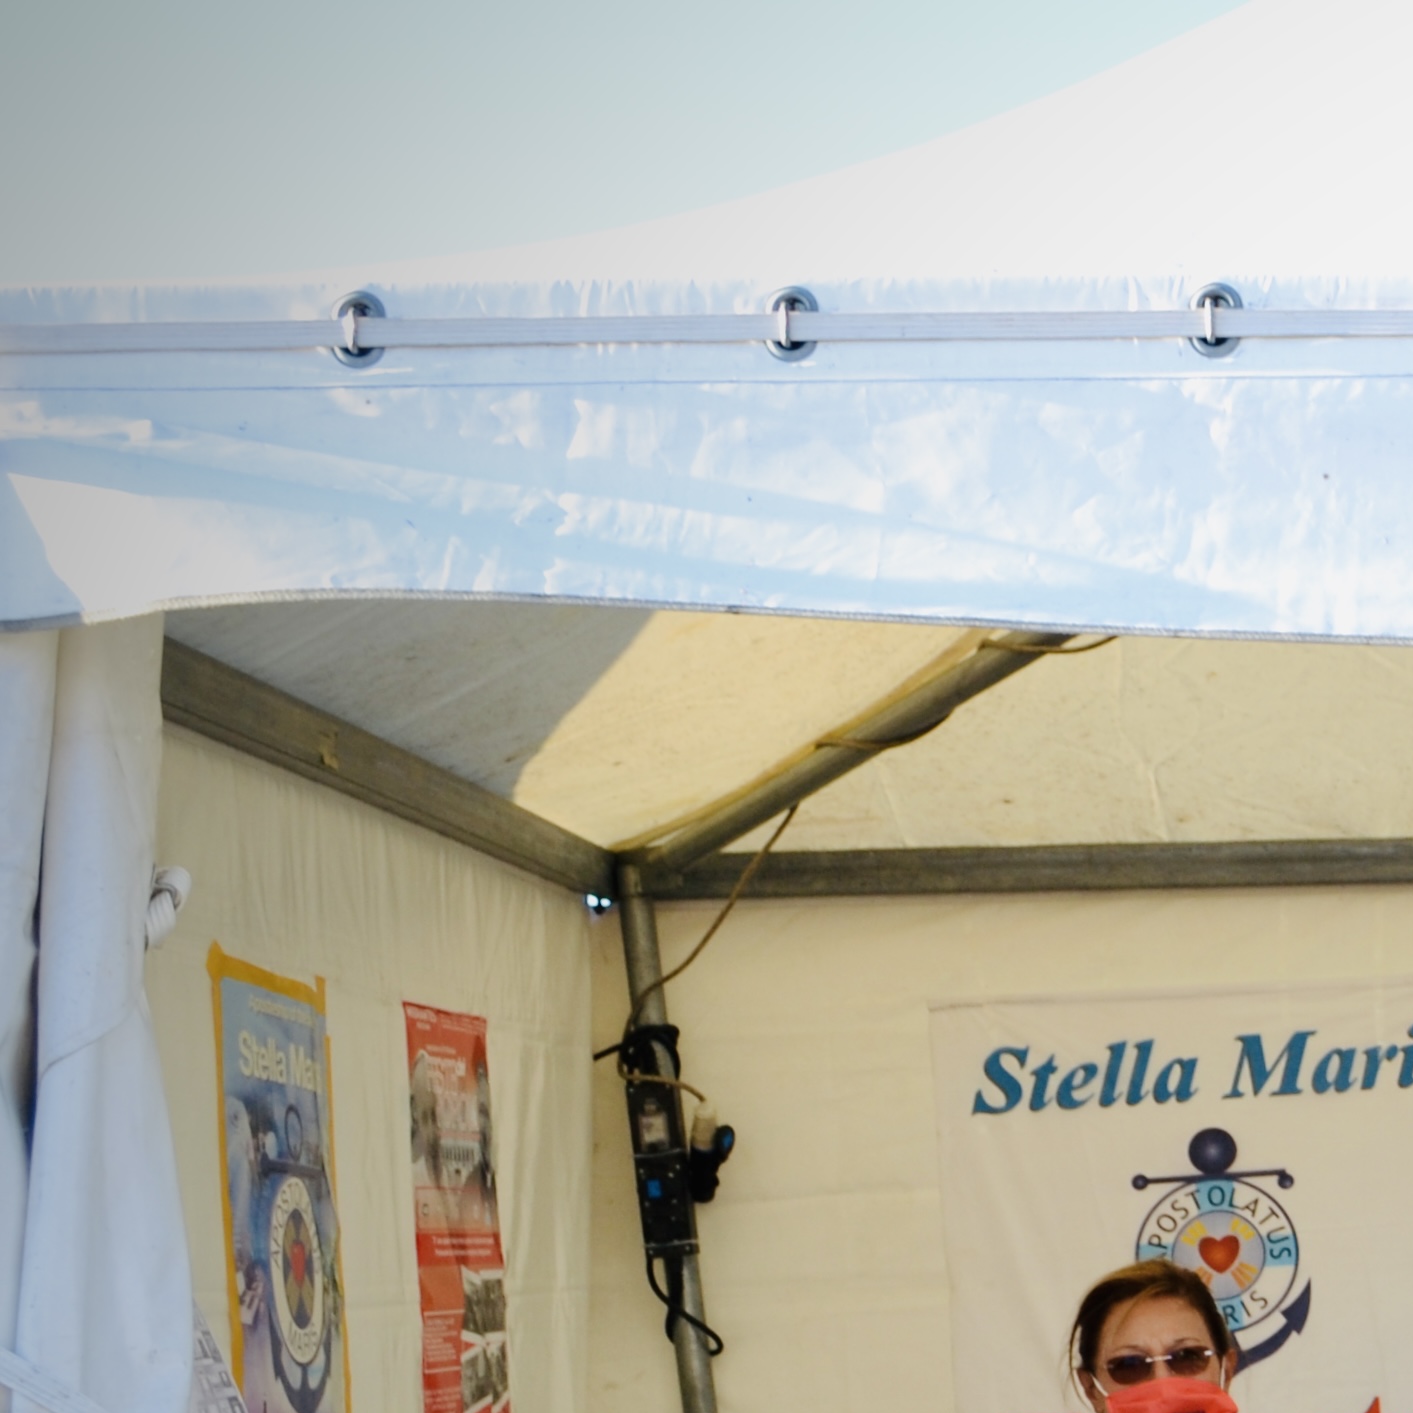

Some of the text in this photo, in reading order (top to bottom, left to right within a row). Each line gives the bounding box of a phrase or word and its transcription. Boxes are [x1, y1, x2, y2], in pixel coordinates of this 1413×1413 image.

[238, 1029, 287, 1086] Stella
[972, 1038, 1199, 1116] Stella
[1147, 1185, 1292, 1260] POSTOLATUS
[1221, 1290, 1269, 1325] RIS
